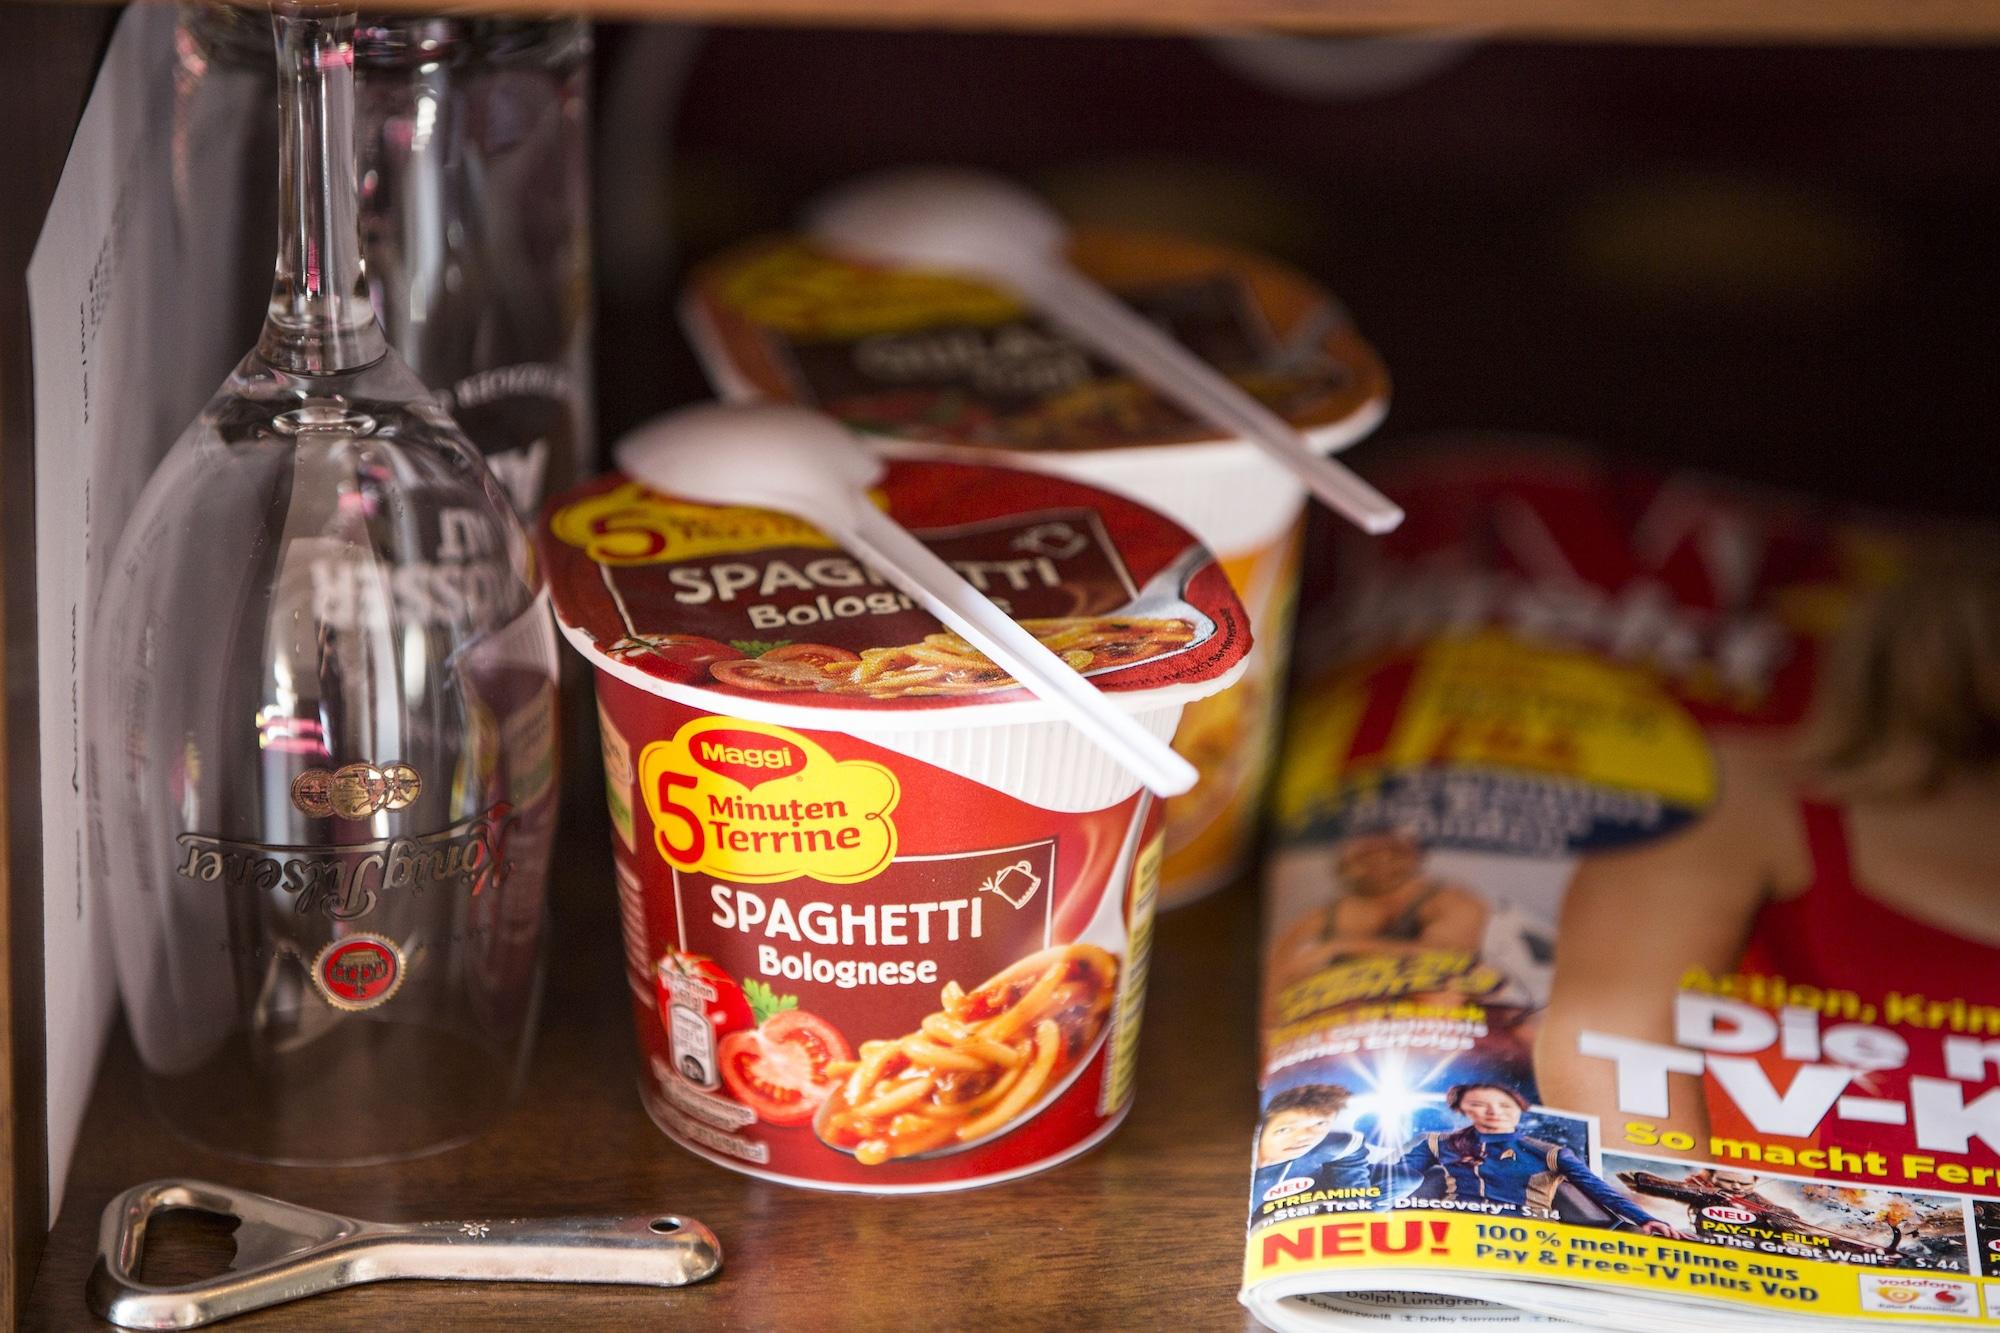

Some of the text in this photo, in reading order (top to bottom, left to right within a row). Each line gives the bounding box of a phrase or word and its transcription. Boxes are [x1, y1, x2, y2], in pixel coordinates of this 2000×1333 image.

[592, 508, 667, 560] 5
[700, 741, 793, 769] Maggi
[658, 771, 705, 864] 5
[707, 794, 848, 821] Minuten
[382, 805, 520, 897] König
[708, 821, 861, 853] Terrine
[177, 845, 384, 921] Pilsener
[710, 884, 982, 946] SPAGHETTI
[757, 943, 938, 989] Bolognese
[1676, 990, 1909, 1070] Die
[1578, 1030, 2000, 1155] TV-K
[1624, 1121, 1695, 1151] So
[1709, 1137, 1888, 1177] macht
[1262, 1186, 1381, 1215] STREAMING
[1269, 1180, 1309, 1197] NEU
[1323, 1199, 1373, 1212] Trek
[1521, 1205, 1537, 1218] S.
[1541, 1208, 1561, 1221] 14
[1702, 1221, 1831, 1248] PAY-TV-FILM
[1708, 1208, 1751, 1222] NEU
[1262, 1220, 1450, 1268] NEU!
[1475, 1223, 1800, 1282] 100 % mehr Filme aus
[1758, 1239, 1826, 1260] Great
[1915, 1257, 1933, 1269] S.
[1936, 1259, 1960, 1271] 44
[1475, 1242, 1820, 1303] Pay & Free-TV plus VoD
[1877, 1279, 1963, 1290] vodafone
